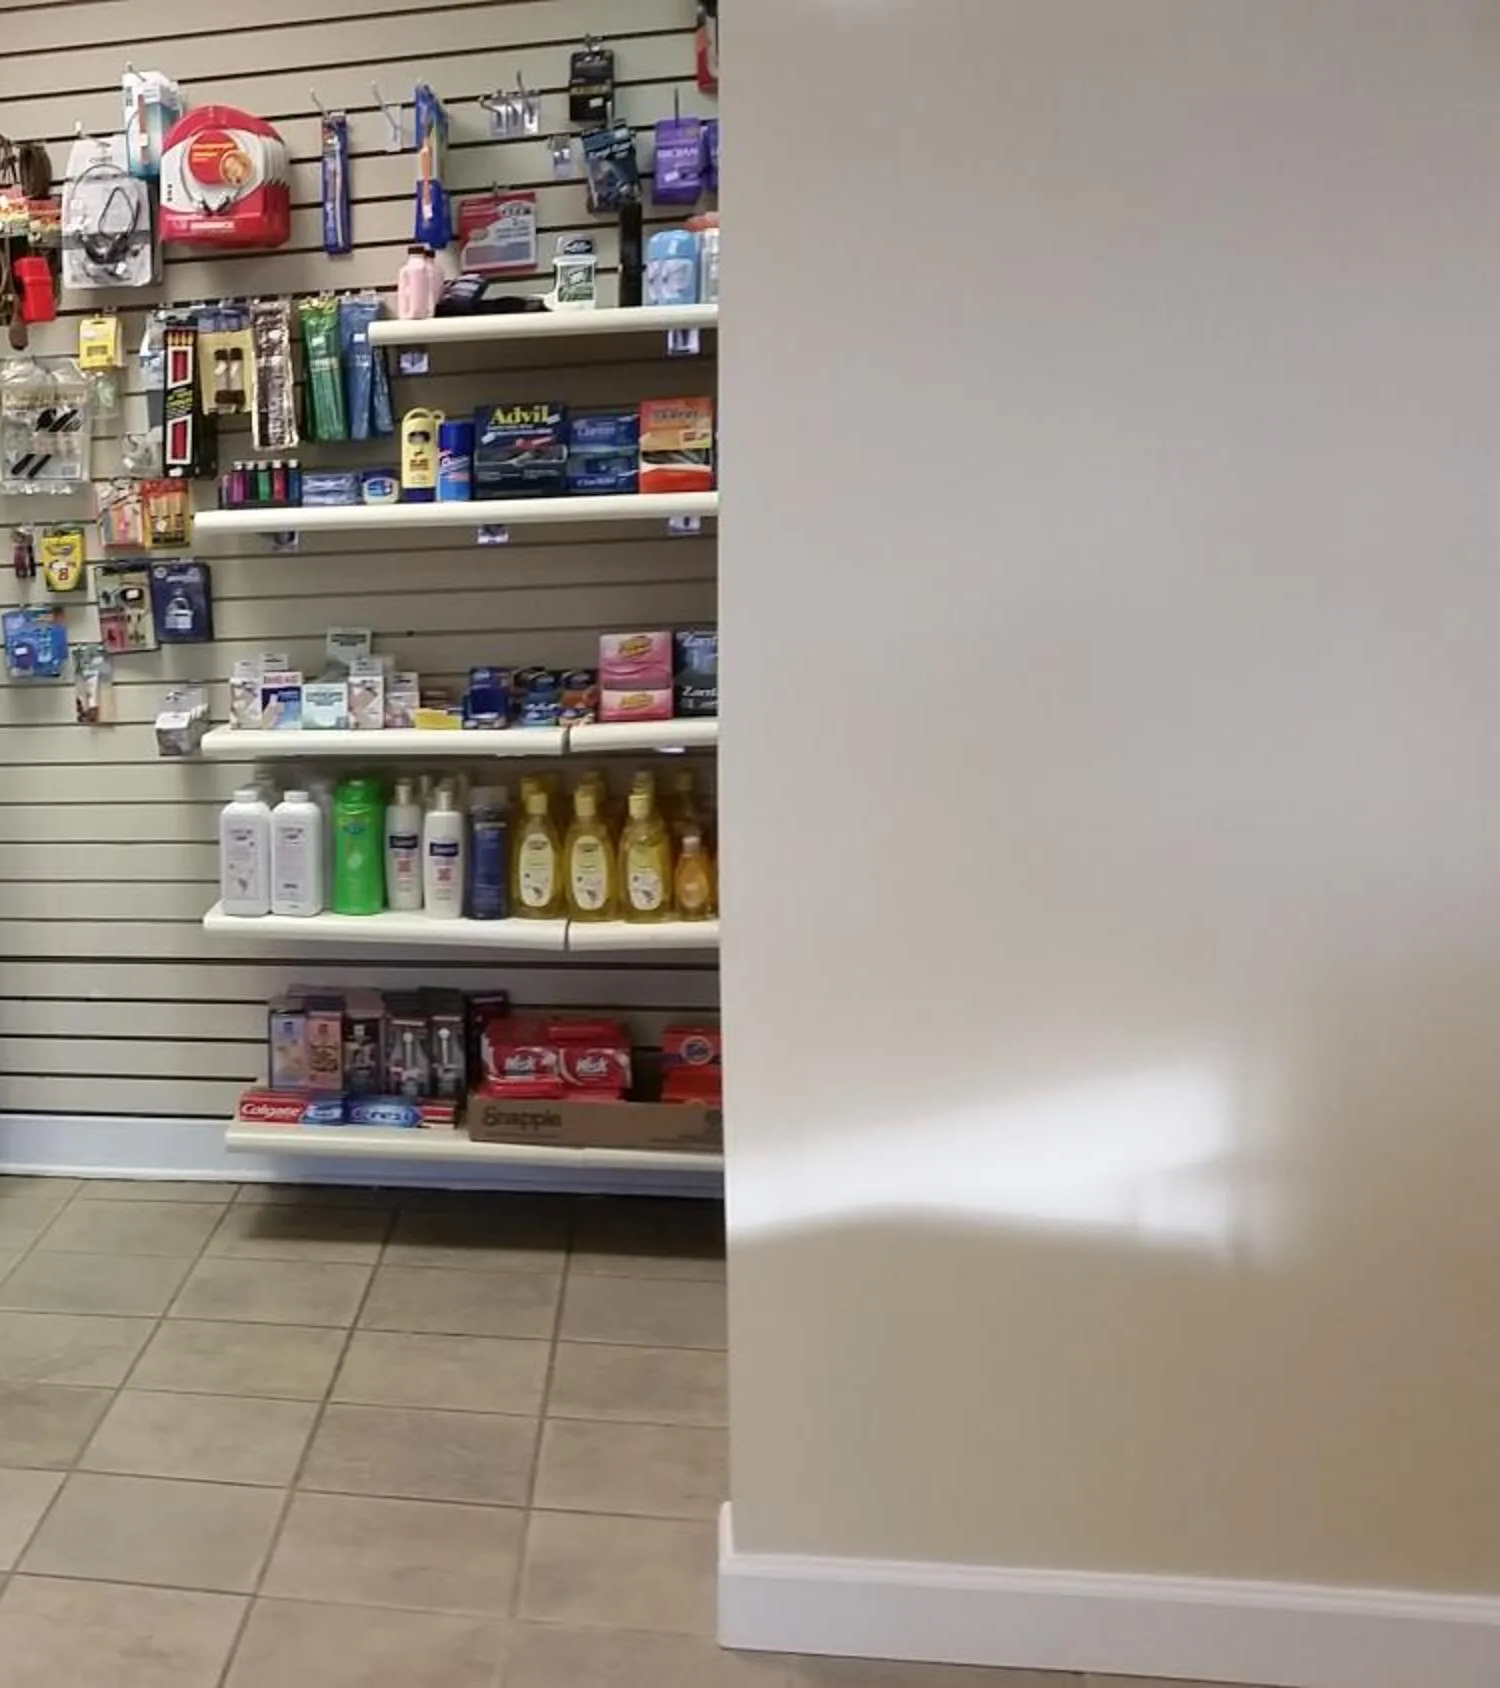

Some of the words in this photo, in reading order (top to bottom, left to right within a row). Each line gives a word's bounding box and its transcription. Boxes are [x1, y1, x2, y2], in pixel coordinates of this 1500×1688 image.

[489, 406, 550, 425] Advil
[682, 685, 717, 697] Zant
[241, 1102, 301, 1118] Colgate
[482, 1106, 563, 1131] Snapple
